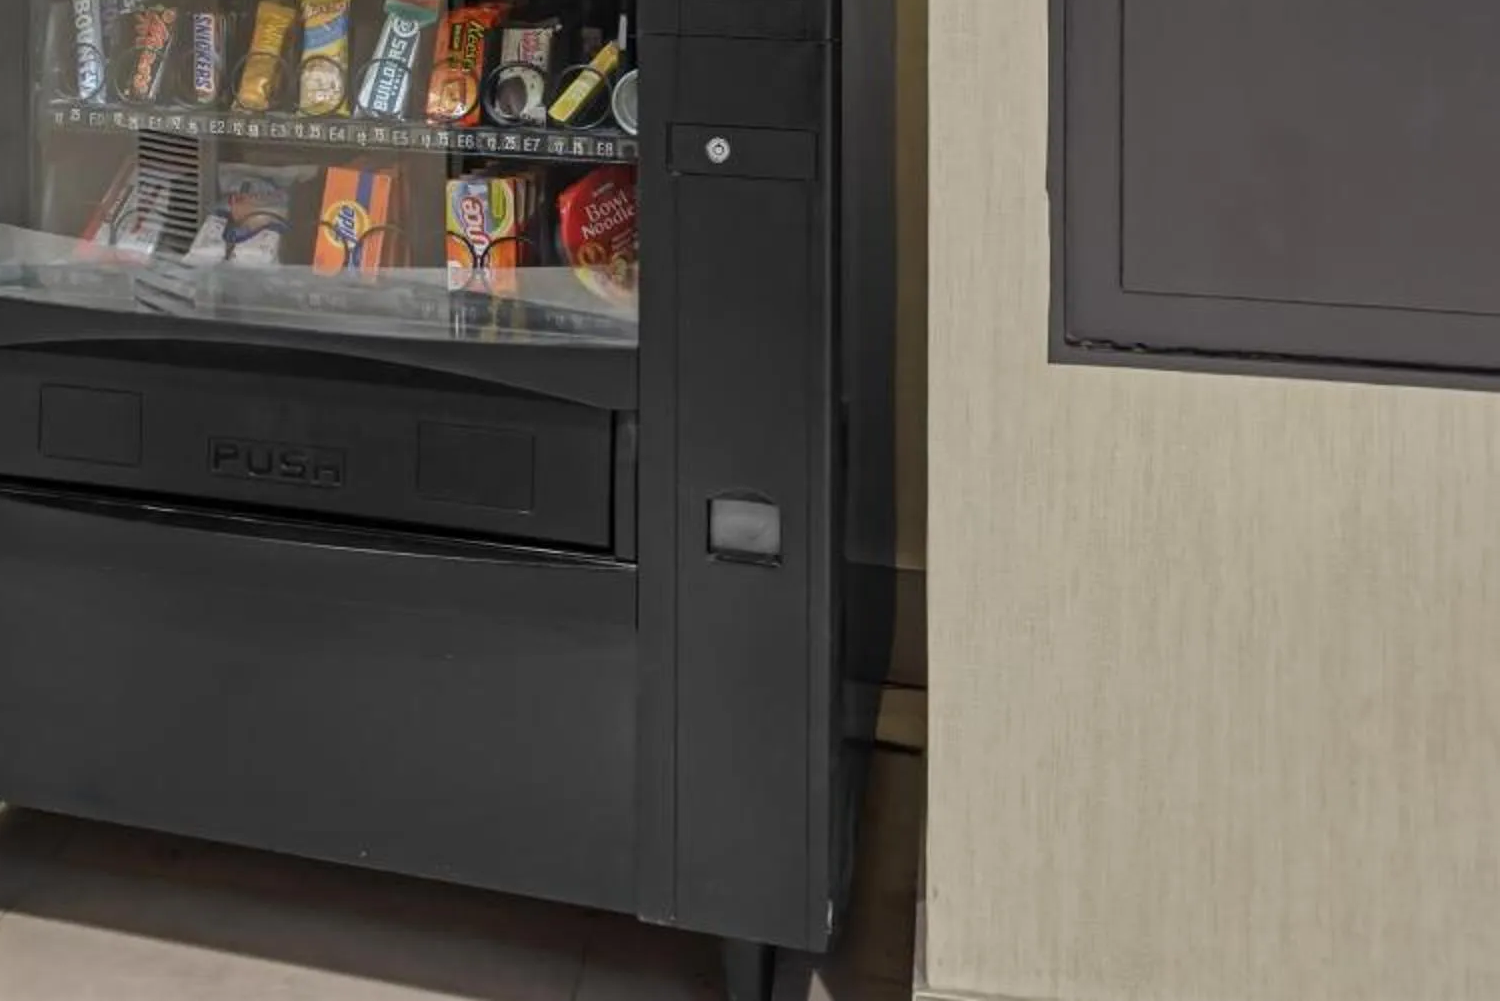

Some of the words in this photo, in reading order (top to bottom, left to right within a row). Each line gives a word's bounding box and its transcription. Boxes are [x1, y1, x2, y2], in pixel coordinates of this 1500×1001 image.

[194, 15, 213, 90] SNICKERS
[523, 137, 541, 152] E7
[579, 206, 637, 239] Noodle
[584, 193, 628, 221] Bowl
[212, 443, 341, 486] PUSH
